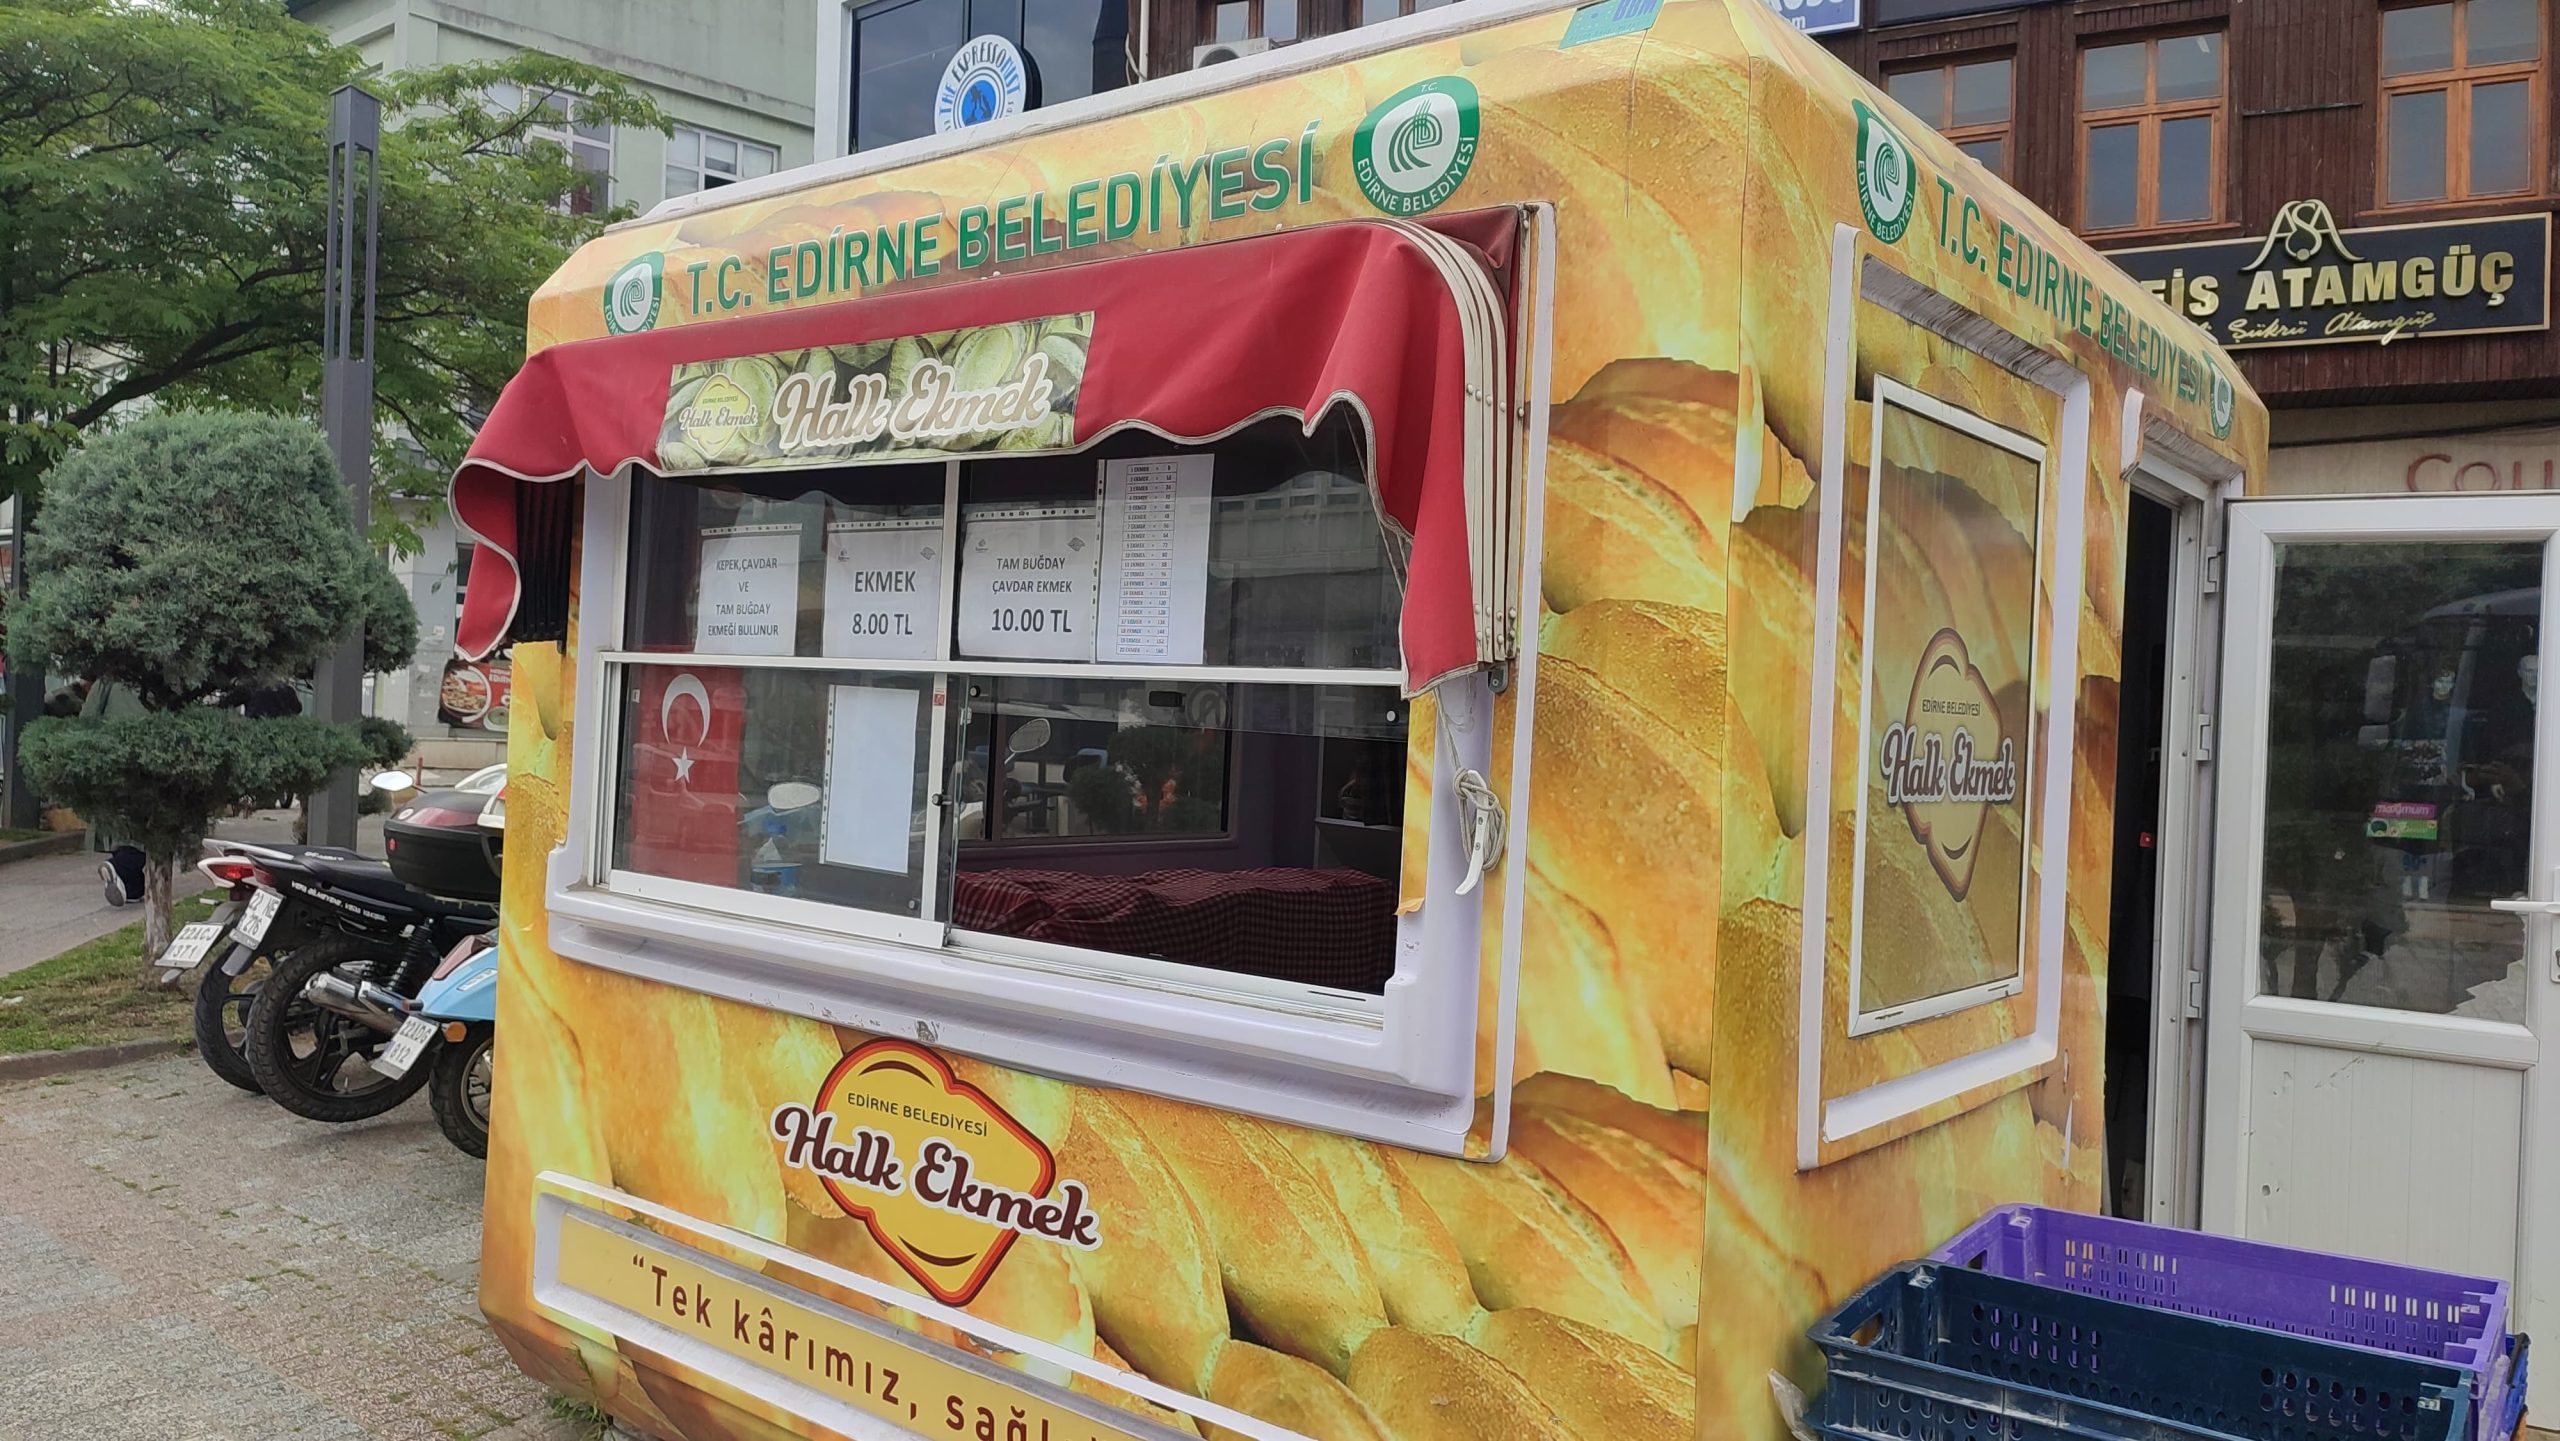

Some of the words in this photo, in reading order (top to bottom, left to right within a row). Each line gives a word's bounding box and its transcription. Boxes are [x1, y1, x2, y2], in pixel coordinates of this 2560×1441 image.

[939, 83, 956, 116] THE
[1358, 158, 1398, 211] EDİRNE
[1403, 137, 1475, 212] BELEDİYESİ
[687, 255, 751, 315] T.C.
[767, 212, 942, 304] EDİRNE
[958, 119, 1321, 270] BELEDİYESİ
[1937, 174, 1986, 274] T.C.
[2245, 244, 2514, 310] ATAMGÜÇ
[2228, 318, 2307, 343] Şükrü
[775, 373, 886, 448] Halk
[891, 353, 1051, 440] Ekmek
[679, 406, 713, 430] Halk
[715, 405, 757, 428] Ekmek
[716, 558, 778, 572] KEPEK,ÇAVDAR
[997, 558, 1019, 570] TAM
[1022, 555, 1065, 570] BUĞDAY
[739, 581, 749, 592] VE
[854, 571, 916, 592] EKMEK
[992, 580, 1034, 594] ÇAVDAR
[1037, 581, 1072, 593] EKMEK
[716, 604, 734, 615] TAM
[736, 601, 771, 615] BUĞDAY
[992, 608, 1044, 632] 10.00
[1050, 610, 1072, 632] TL
[708, 622, 736, 636] EKMEĞİ
[738, 625, 778, 636] BULUNUR
[852, 613, 888, 635] 8.00
[894, 614, 912, 635] TL
[1882, 727, 1945, 798] Halk
[1949, 731, 2014, 797] Ekmek
[847, 1092, 899, 1116] EDİRNE
[903, 1106, 987, 1137] BELEDİYESİ
[774, 1106, 902, 1190] Halk
[914, 1142, 1097, 1246] Ekmek
